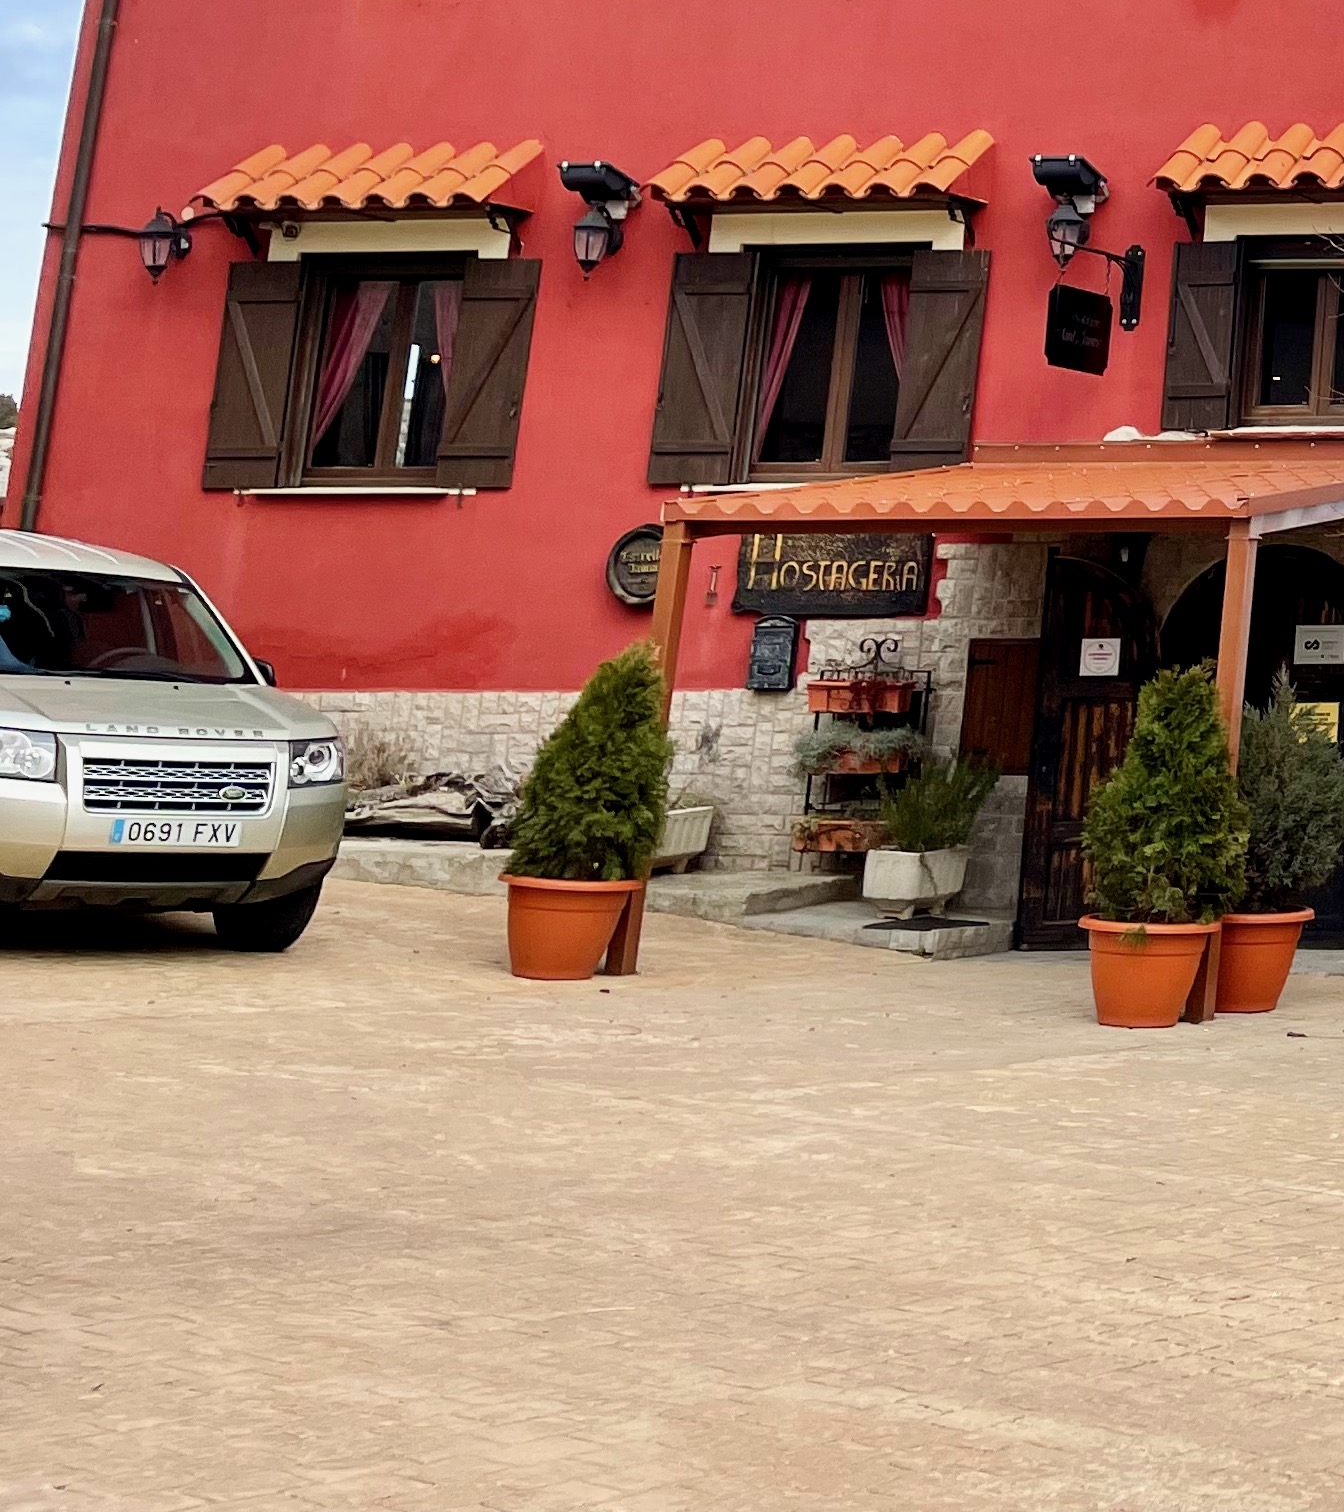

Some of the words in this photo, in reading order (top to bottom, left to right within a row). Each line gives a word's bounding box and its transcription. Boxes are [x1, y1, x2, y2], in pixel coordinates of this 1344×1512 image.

[85, 723, 159, 734] LAND
[177, 728, 264, 737] ROVER
[128, 822, 183, 842] 0691
[192, 823, 237, 843] FXV
